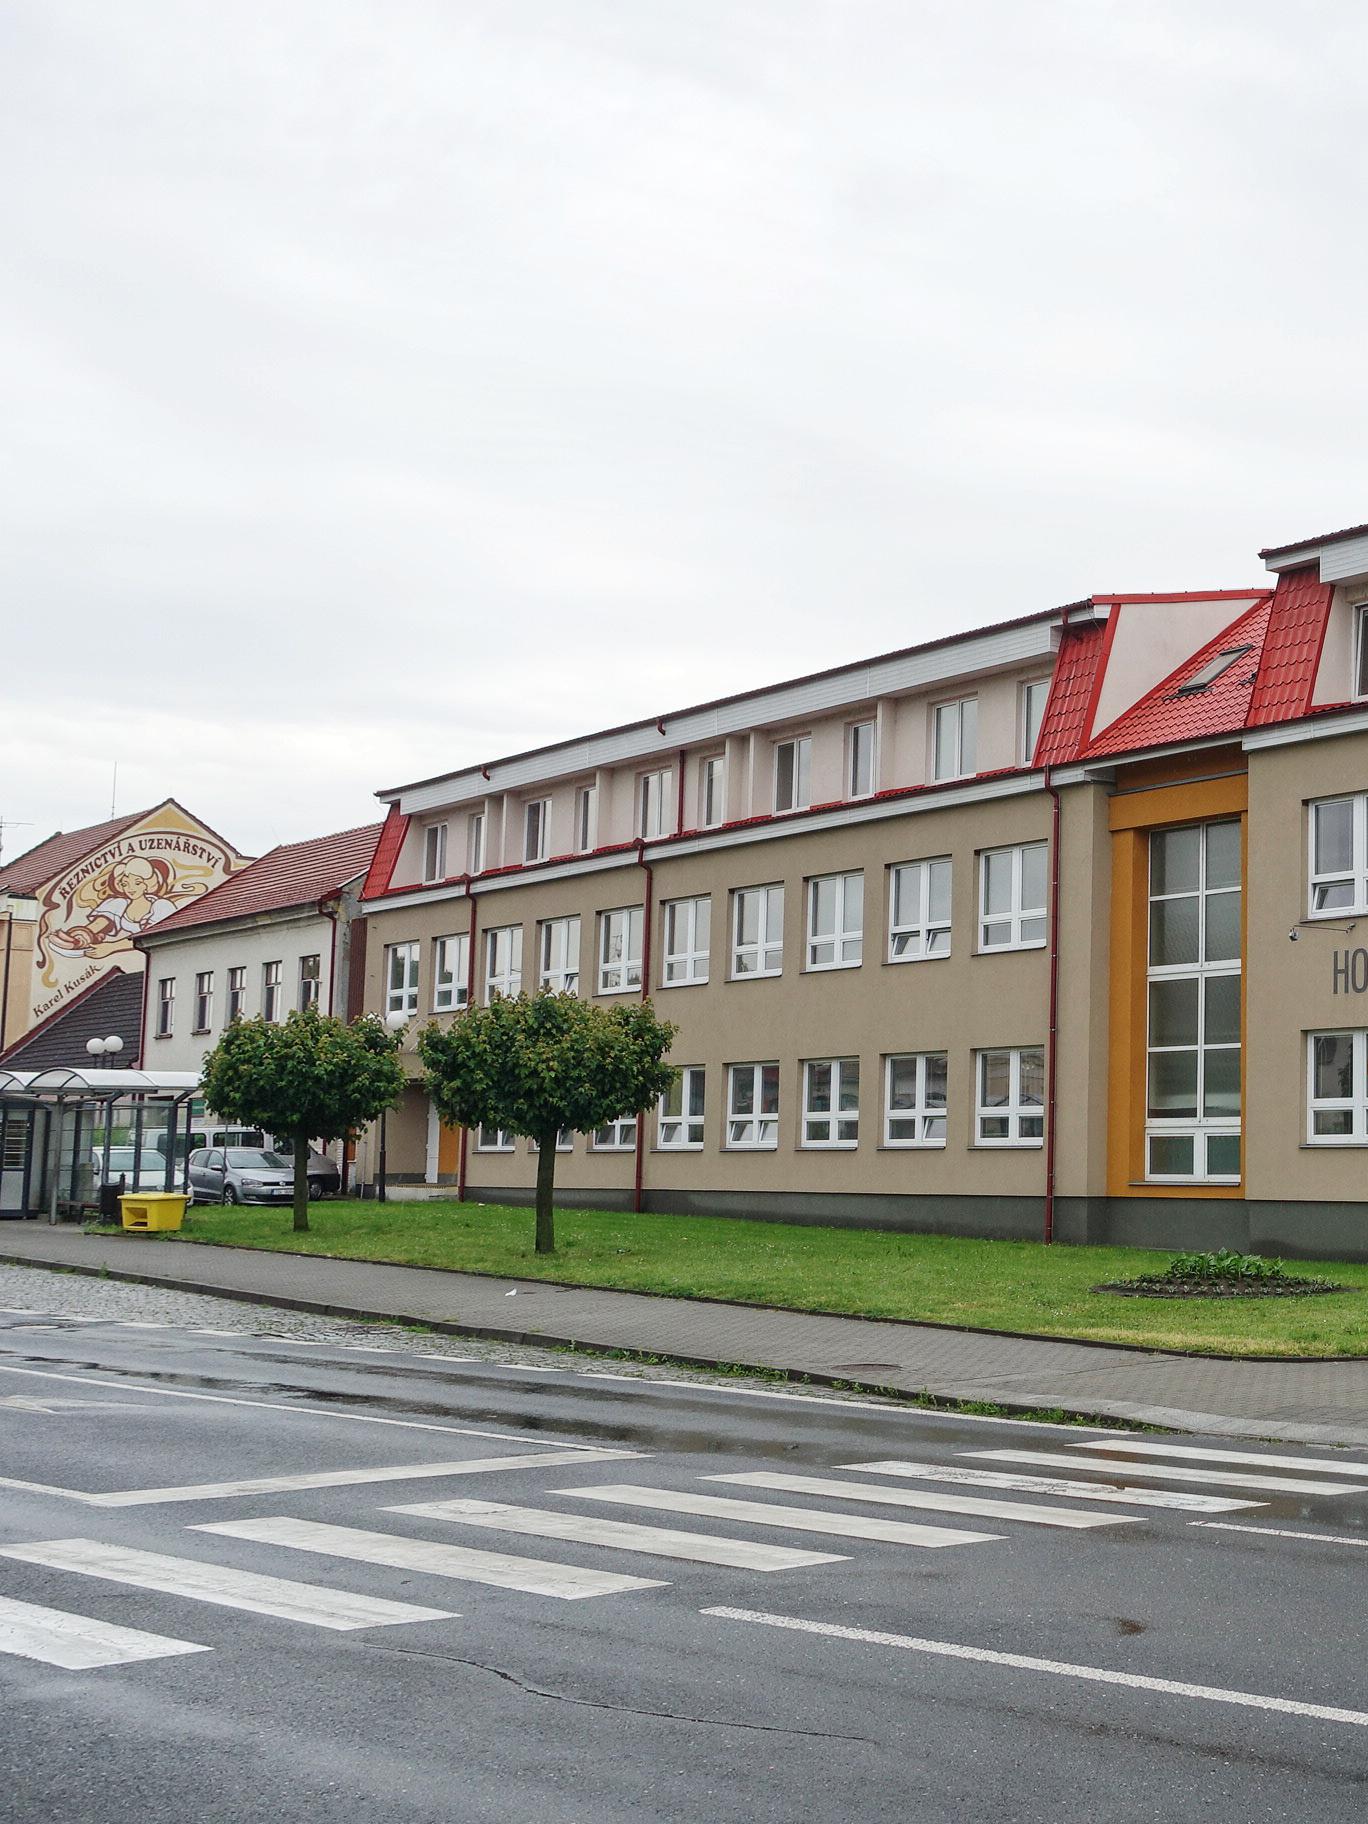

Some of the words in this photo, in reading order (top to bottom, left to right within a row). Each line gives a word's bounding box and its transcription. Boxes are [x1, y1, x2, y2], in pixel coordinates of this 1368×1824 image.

[59, 841, 123, 900] ŘEZNICTVÍ
[126, 843, 136, 854] A
[139, 836, 222, 869] UZENÁŘSTVÍ
[33, 989, 63, 1018] Karel
[64, 964, 104, 994] Kusák
